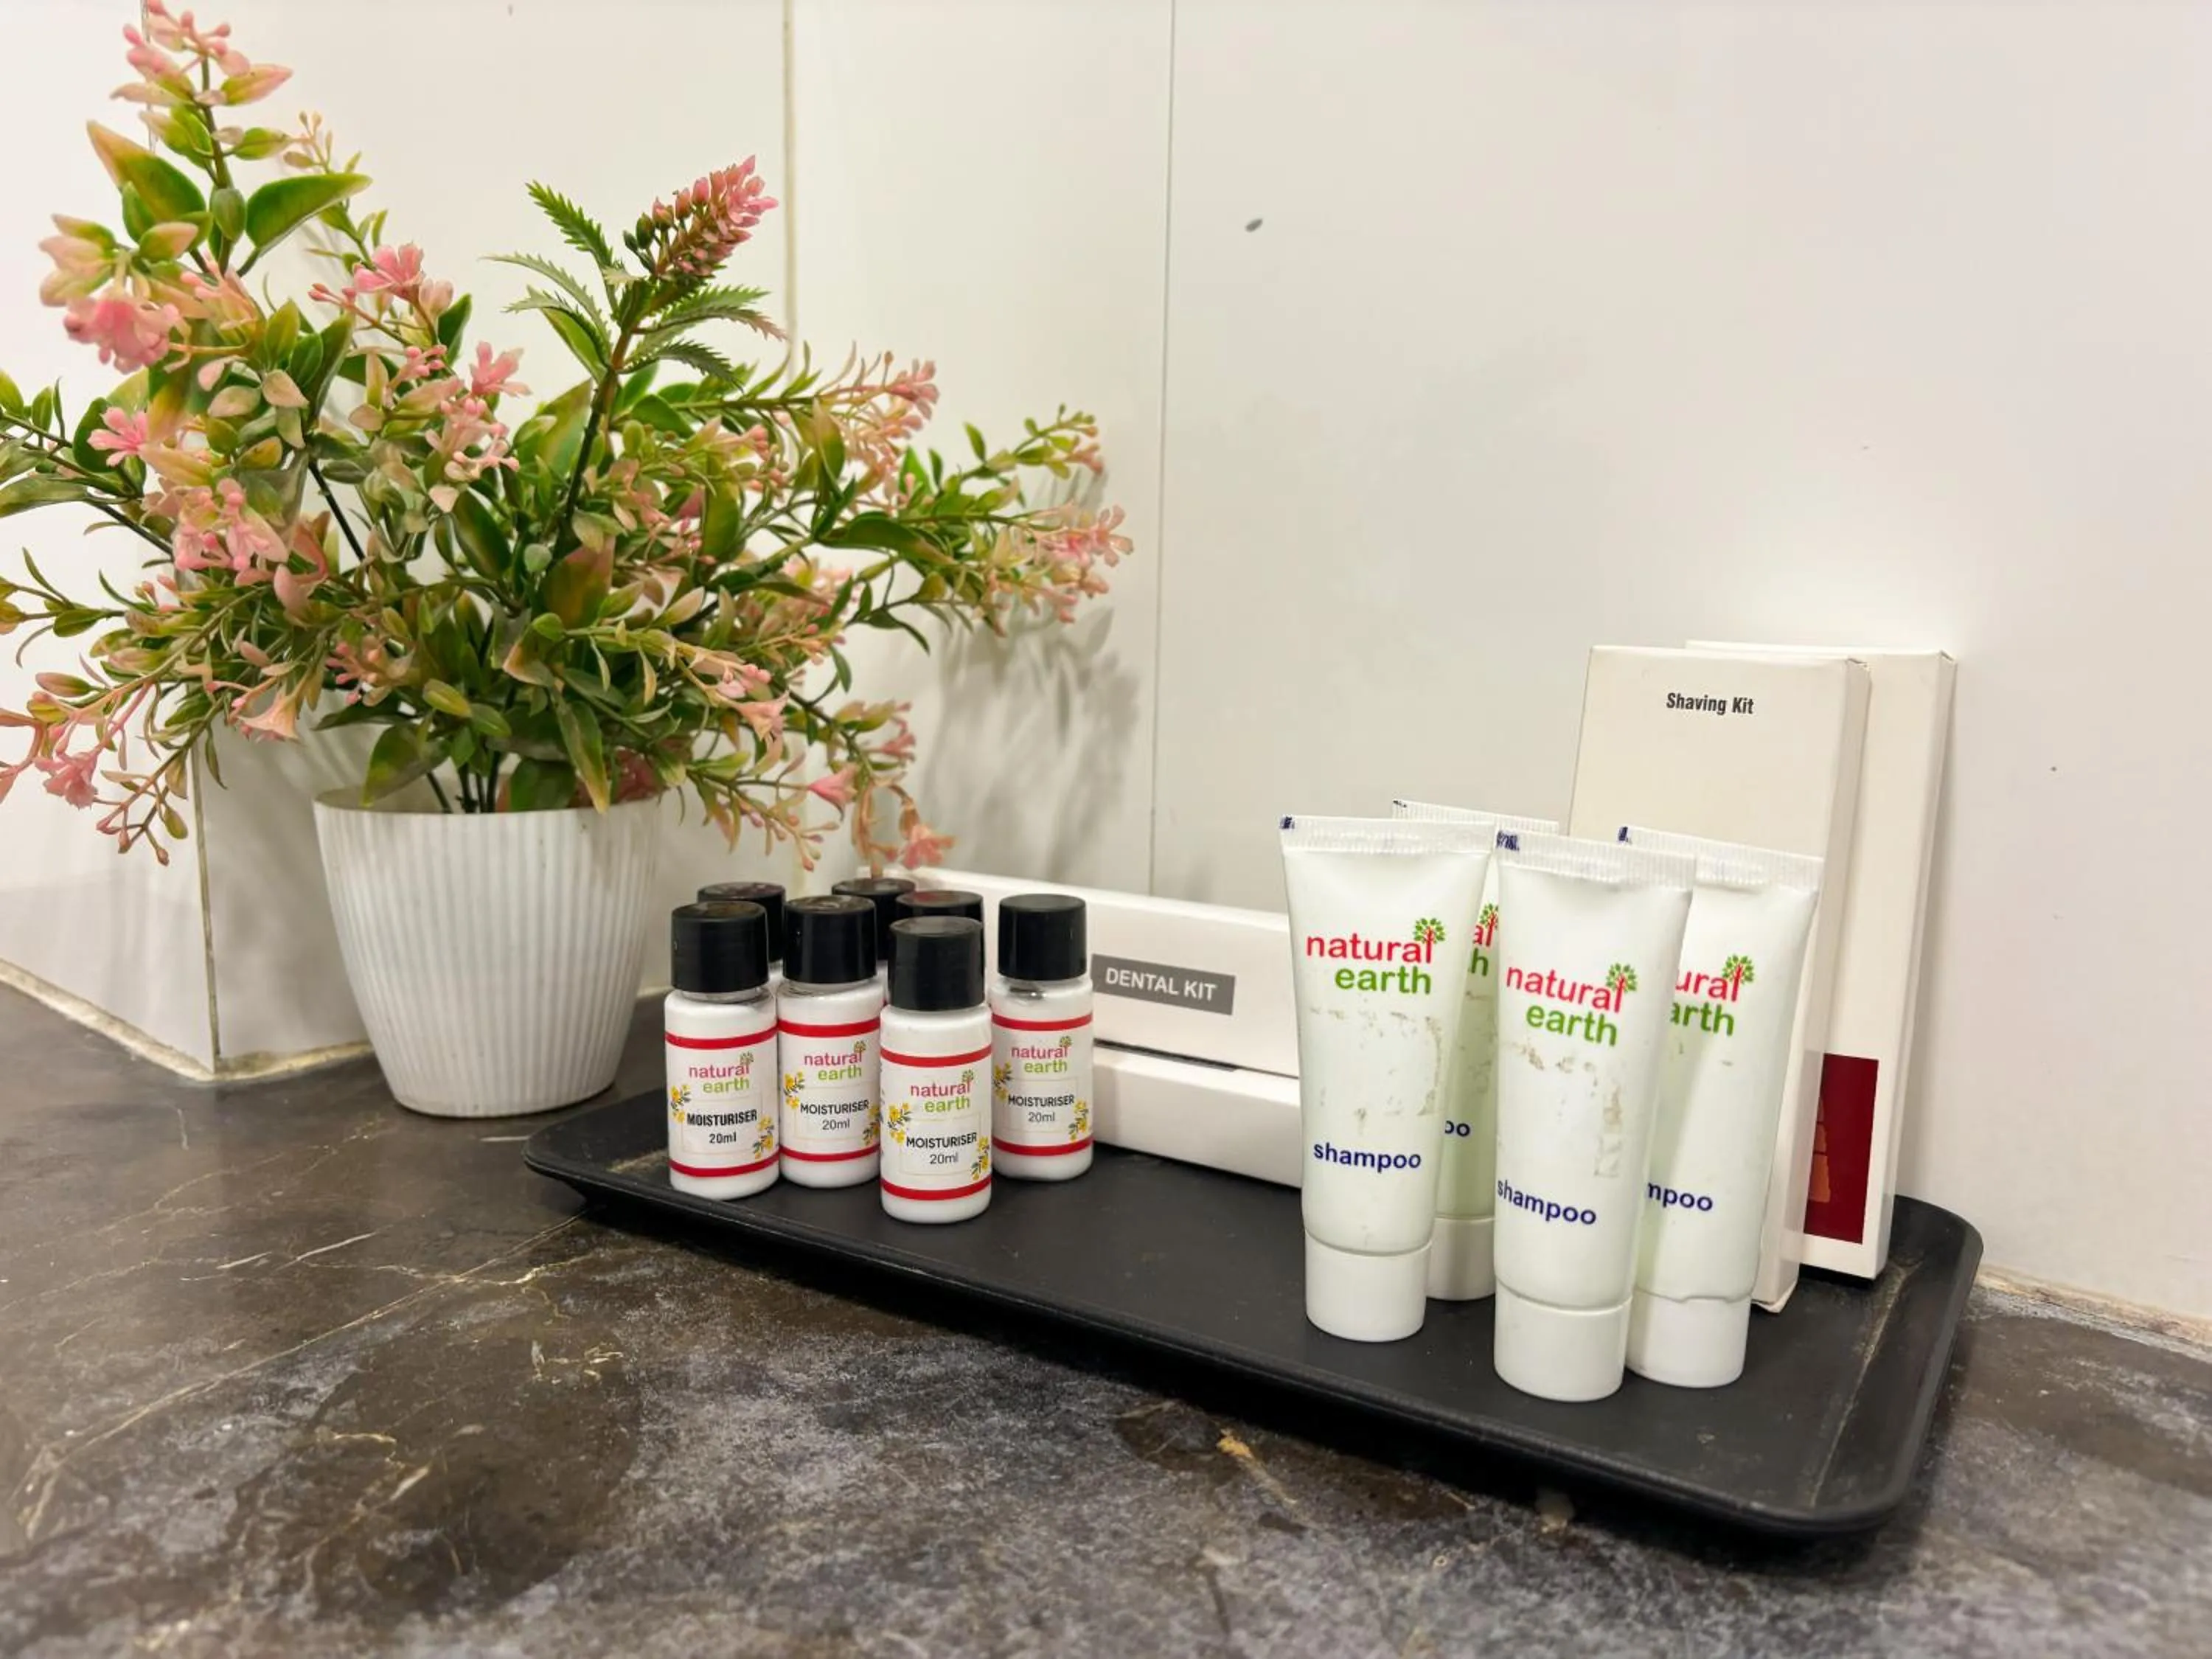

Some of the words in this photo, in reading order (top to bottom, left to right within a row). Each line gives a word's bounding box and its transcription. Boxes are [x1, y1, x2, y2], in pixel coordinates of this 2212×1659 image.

[1666, 692, 1727, 716] Shaving
[1732, 696, 1754, 714] Kit
[1307, 926, 1432, 964] natural
[1105, 967, 1180, 995] DENTAL
[1183, 979, 1217, 1002] KIT
[1335, 965, 1432, 995] earth
[1674, 964, 1743, 1003] ural
[1506, 966, 1626, 1014] natural
[1526, 1004, 1618, 1046] earth
[1669, 1001, 1735, 1037] arth
[803, 1051, 863, 1066] natural
[1011, 1044, 1069, 1060] natural
[688, 1062, 750, 1079] natural
[818, 1065, 862, 1081] earth
[1023, 1060, 1068, 1074] earth
[702, 1077, 750, 1094] earth
[910, 1080, 972, 1098] natural
[800, 1099, 869, 1116] MOISTURISER
[924, 1096, 970, 1113] earth
[1007, 1094, 1075, 1107] MOISTURISER
[686, 1109, 758, 1127] MOISTURISER
[821, 1119, 850, 1131] 20ml
[1028, 1111, 1055, 1123] 20ml
[709, 1131, 737, 1144] 20ml
[905, 1132, 978, 1149] MOISTURISER
[929, 1152, 959, 1165] 20ml
[1313, 1141, 1422, 1174] shampoo
[1497, 1179, 1597, 1225] shampoo
